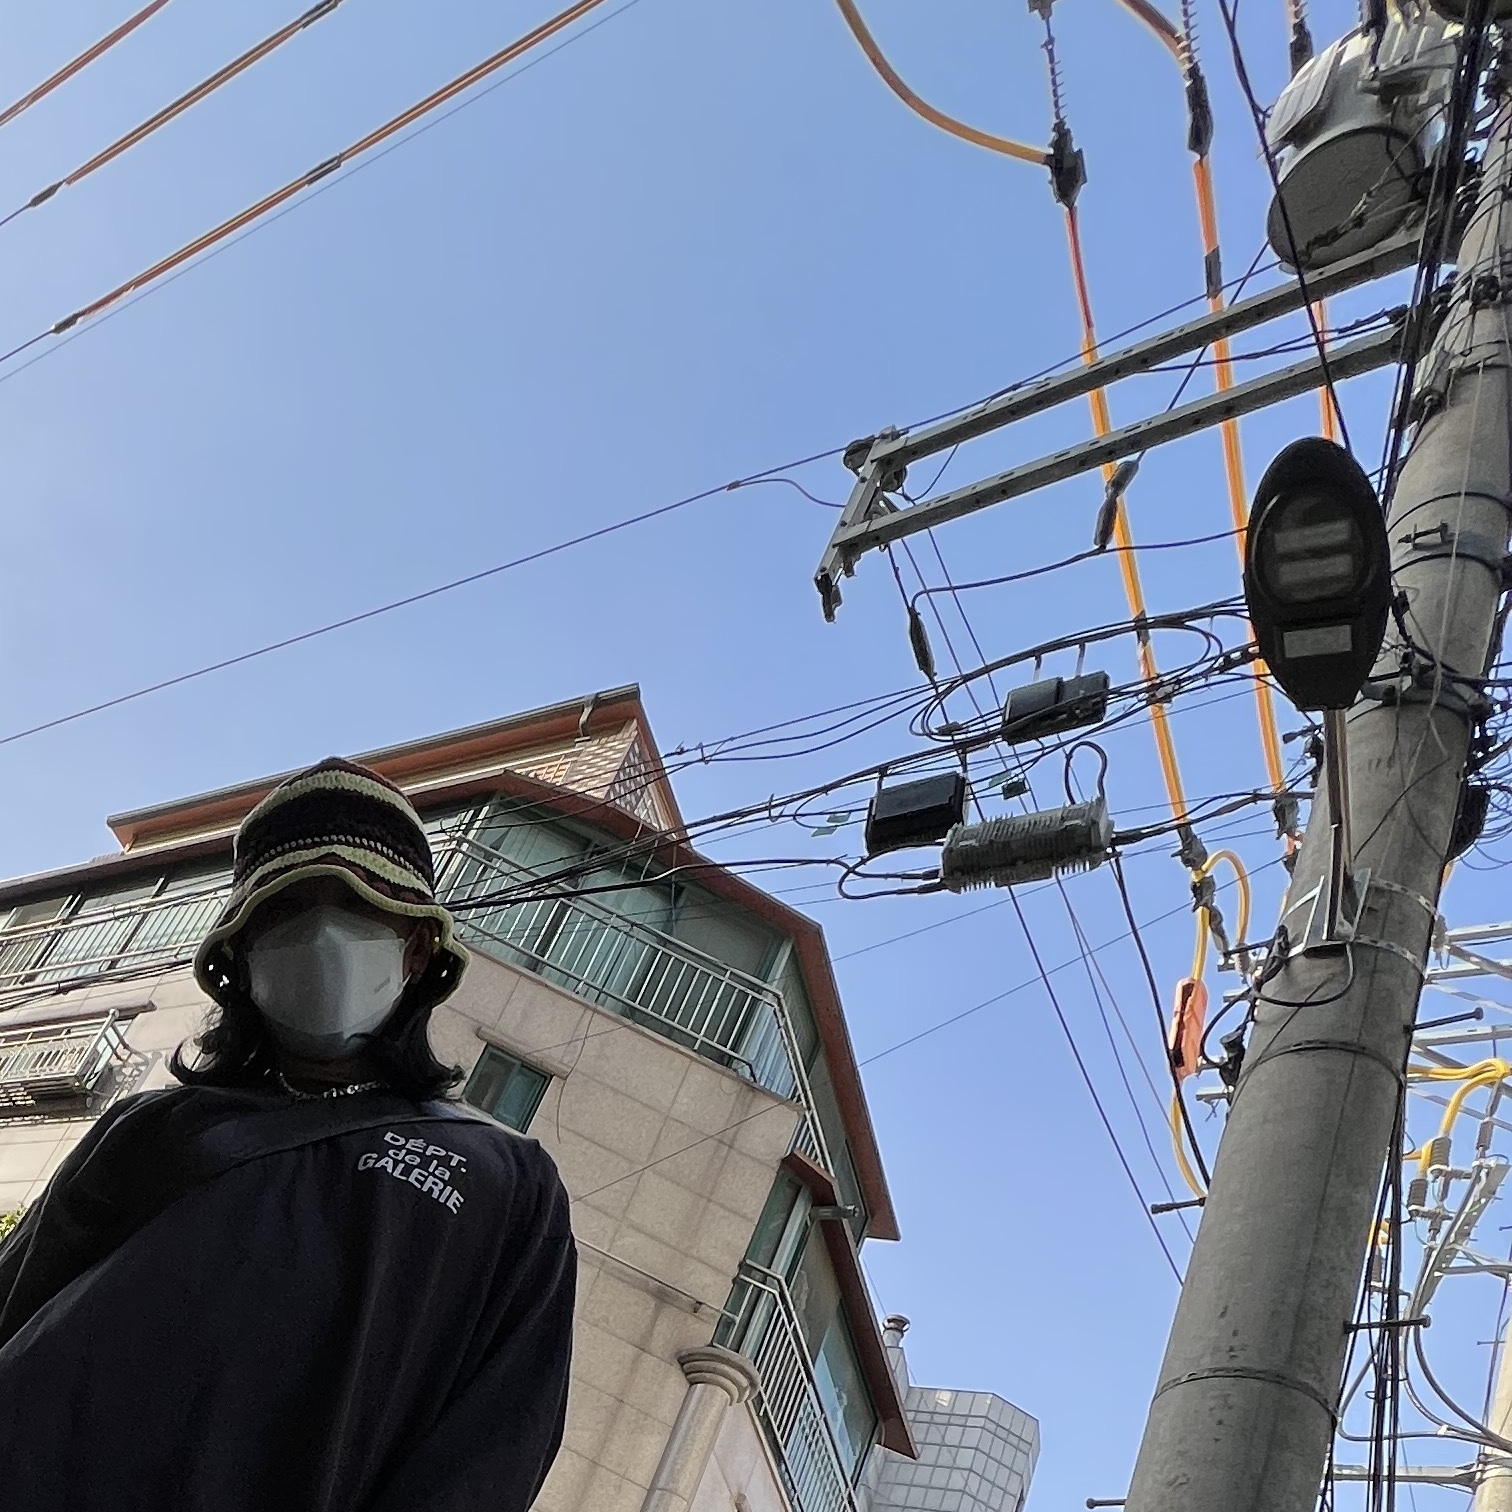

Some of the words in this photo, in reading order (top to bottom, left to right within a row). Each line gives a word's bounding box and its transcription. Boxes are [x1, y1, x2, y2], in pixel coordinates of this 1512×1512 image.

[383, 1131, 467, 1173] DÉPT.
[387, 1148, 421, 1166] de
[427, 1159, 451, 1182] la
[357, 1152, 465, 1215] GALERIE
